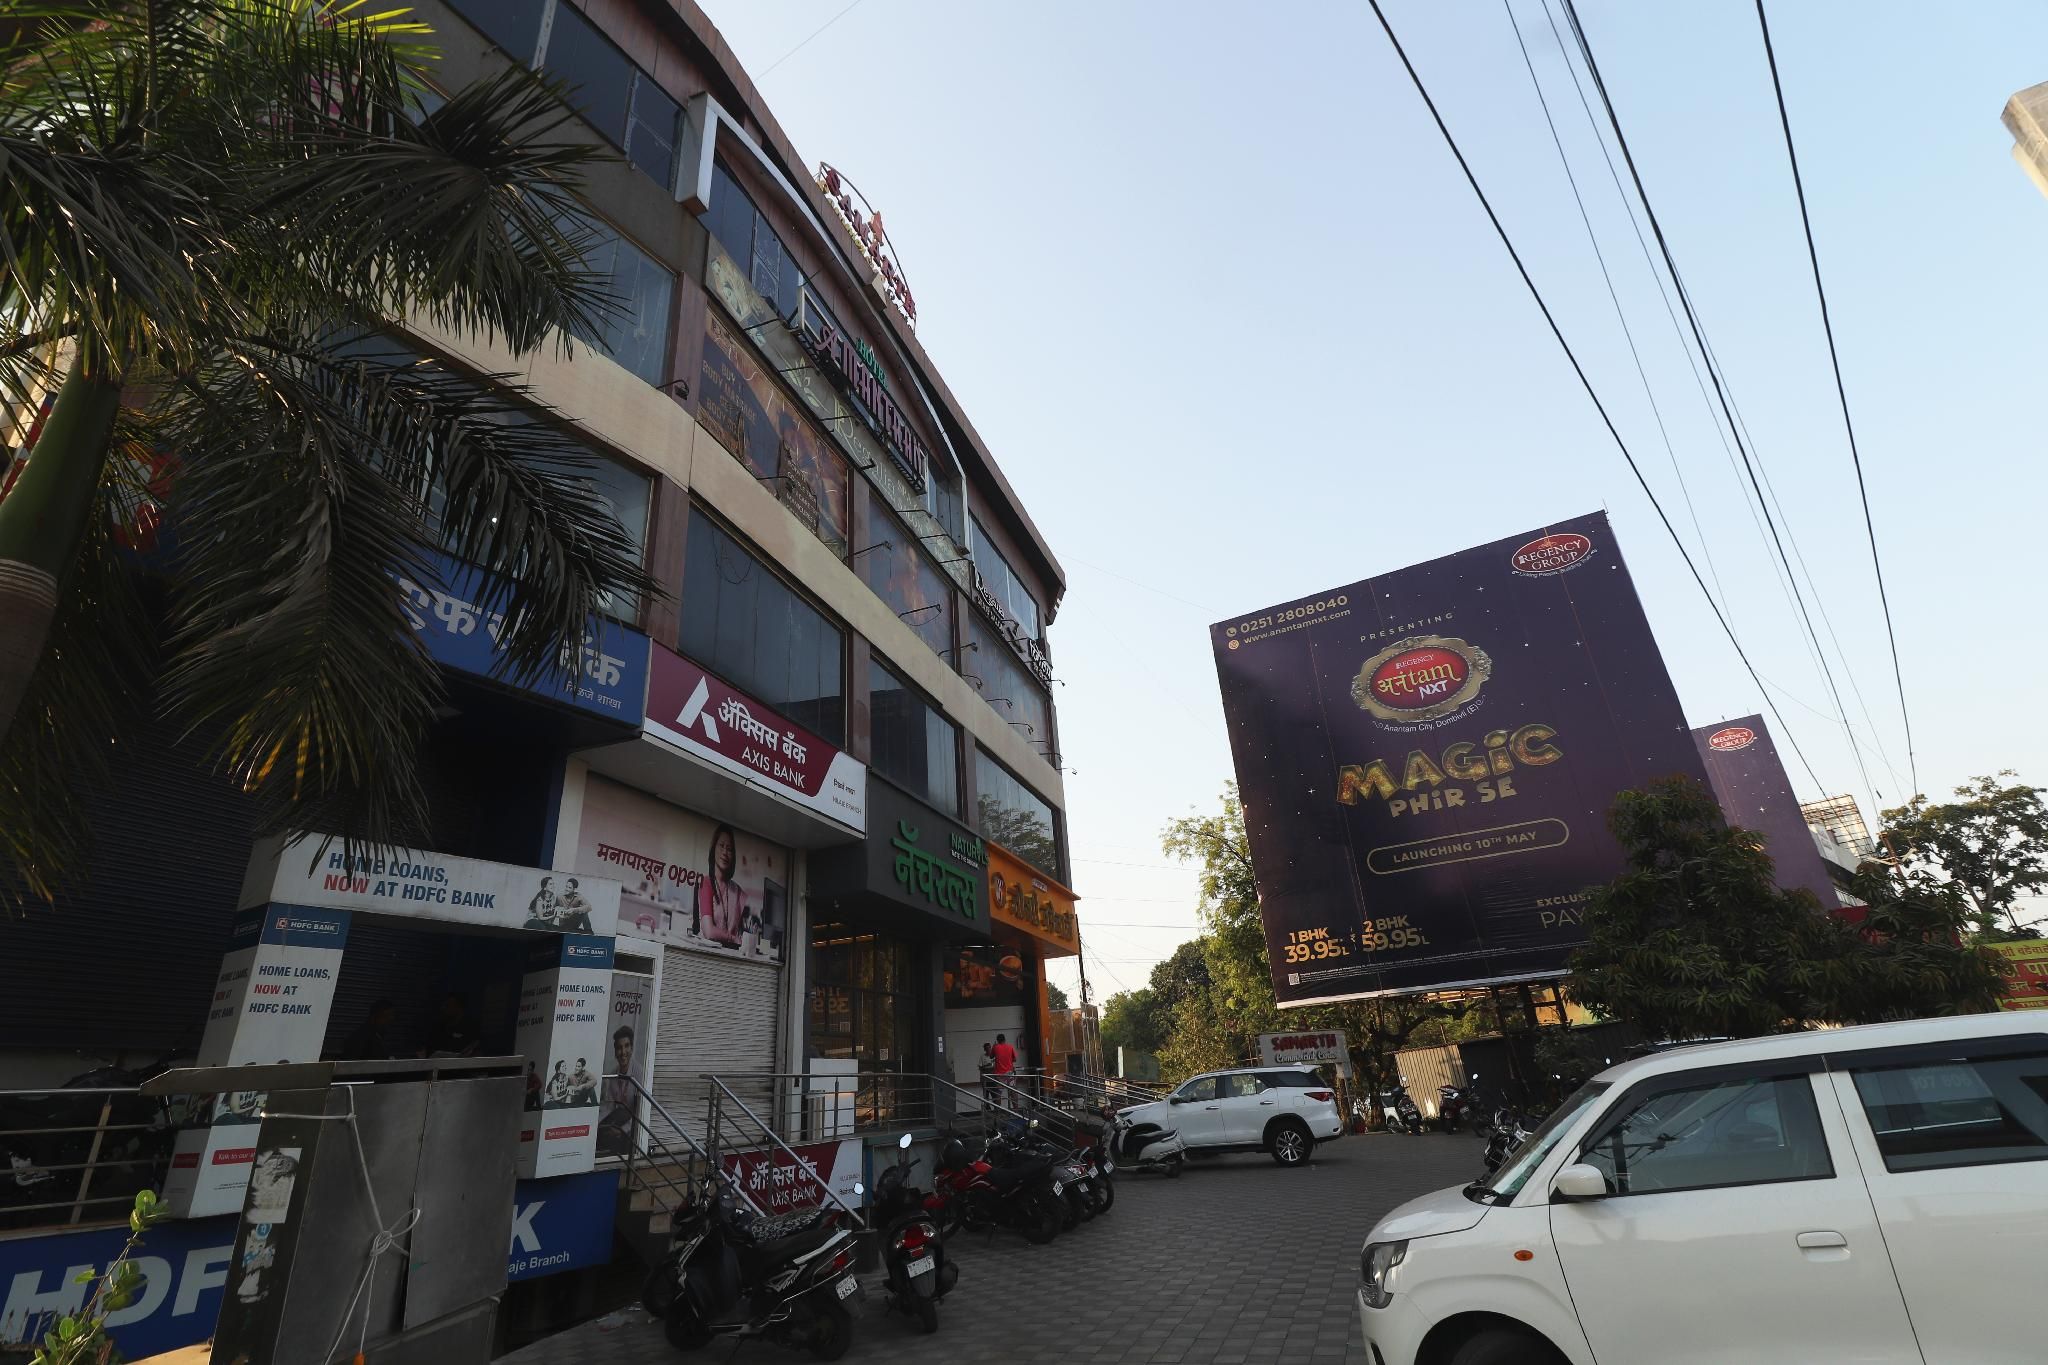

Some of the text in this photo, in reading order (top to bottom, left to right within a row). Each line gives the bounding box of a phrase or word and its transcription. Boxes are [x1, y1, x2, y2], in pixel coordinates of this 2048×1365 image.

[856, 337, 888, 390] HOTEL
[1518, 540, 1581, 564] REGENCY
[1532, 551, 1578, 570] GROUP
[1240, 595, 1348, 633] 0251 2808040
[1244, 609, 1351, 644] www.anantamnxt.com
[1360, 612, 1453, 642] PRESENTING
[1396, 654, 1434, 669] REGENCY
[1418, 680, 1448, 700] NXT
[1384, 724, 1417, 733] Anantam
[1436, 710, 1467, 728] Dombivli
[1467, 702, 1479, 715] (E)
[782, 731, 806, 765] बँक
[1713, 731, 1748, 743] REGENCY
[741, 746, 806, 789] AXIS BANK
[1476, 776, 1518, 803] SE
[1393, 842, 1472, 864] LAUNCHING
[1506, 831, 1537, 845] MAY
[329, 852, 449, 887] HOME LOANS,
[597, 842, 704, 887] मनापासून open
[892, 817, 978, 920] नॅचरल्स
[323, 874, 496, 909] NOW AT HDFC BANK
[290, 921, 336, 932] HDFC BANK
[1289, 914, 1411, 944] 1 BHK 2 BHK
[259, 965, 331, 981] HOME LOANS,
[254, 984, 298, 996] NOW AT
[560, 985, 605, 994] HOME LOANS,
[248, 1003, 312, 1015] HDFC BANK
[558, 999, 575, 1007] NOW
[615, 1001, 641, 1016] open
[556, 1014, 595, 1022] HDFC BANK
[792, 1184, 817, 1202] BANK
[529, 1250, 570, 1269] Branch
